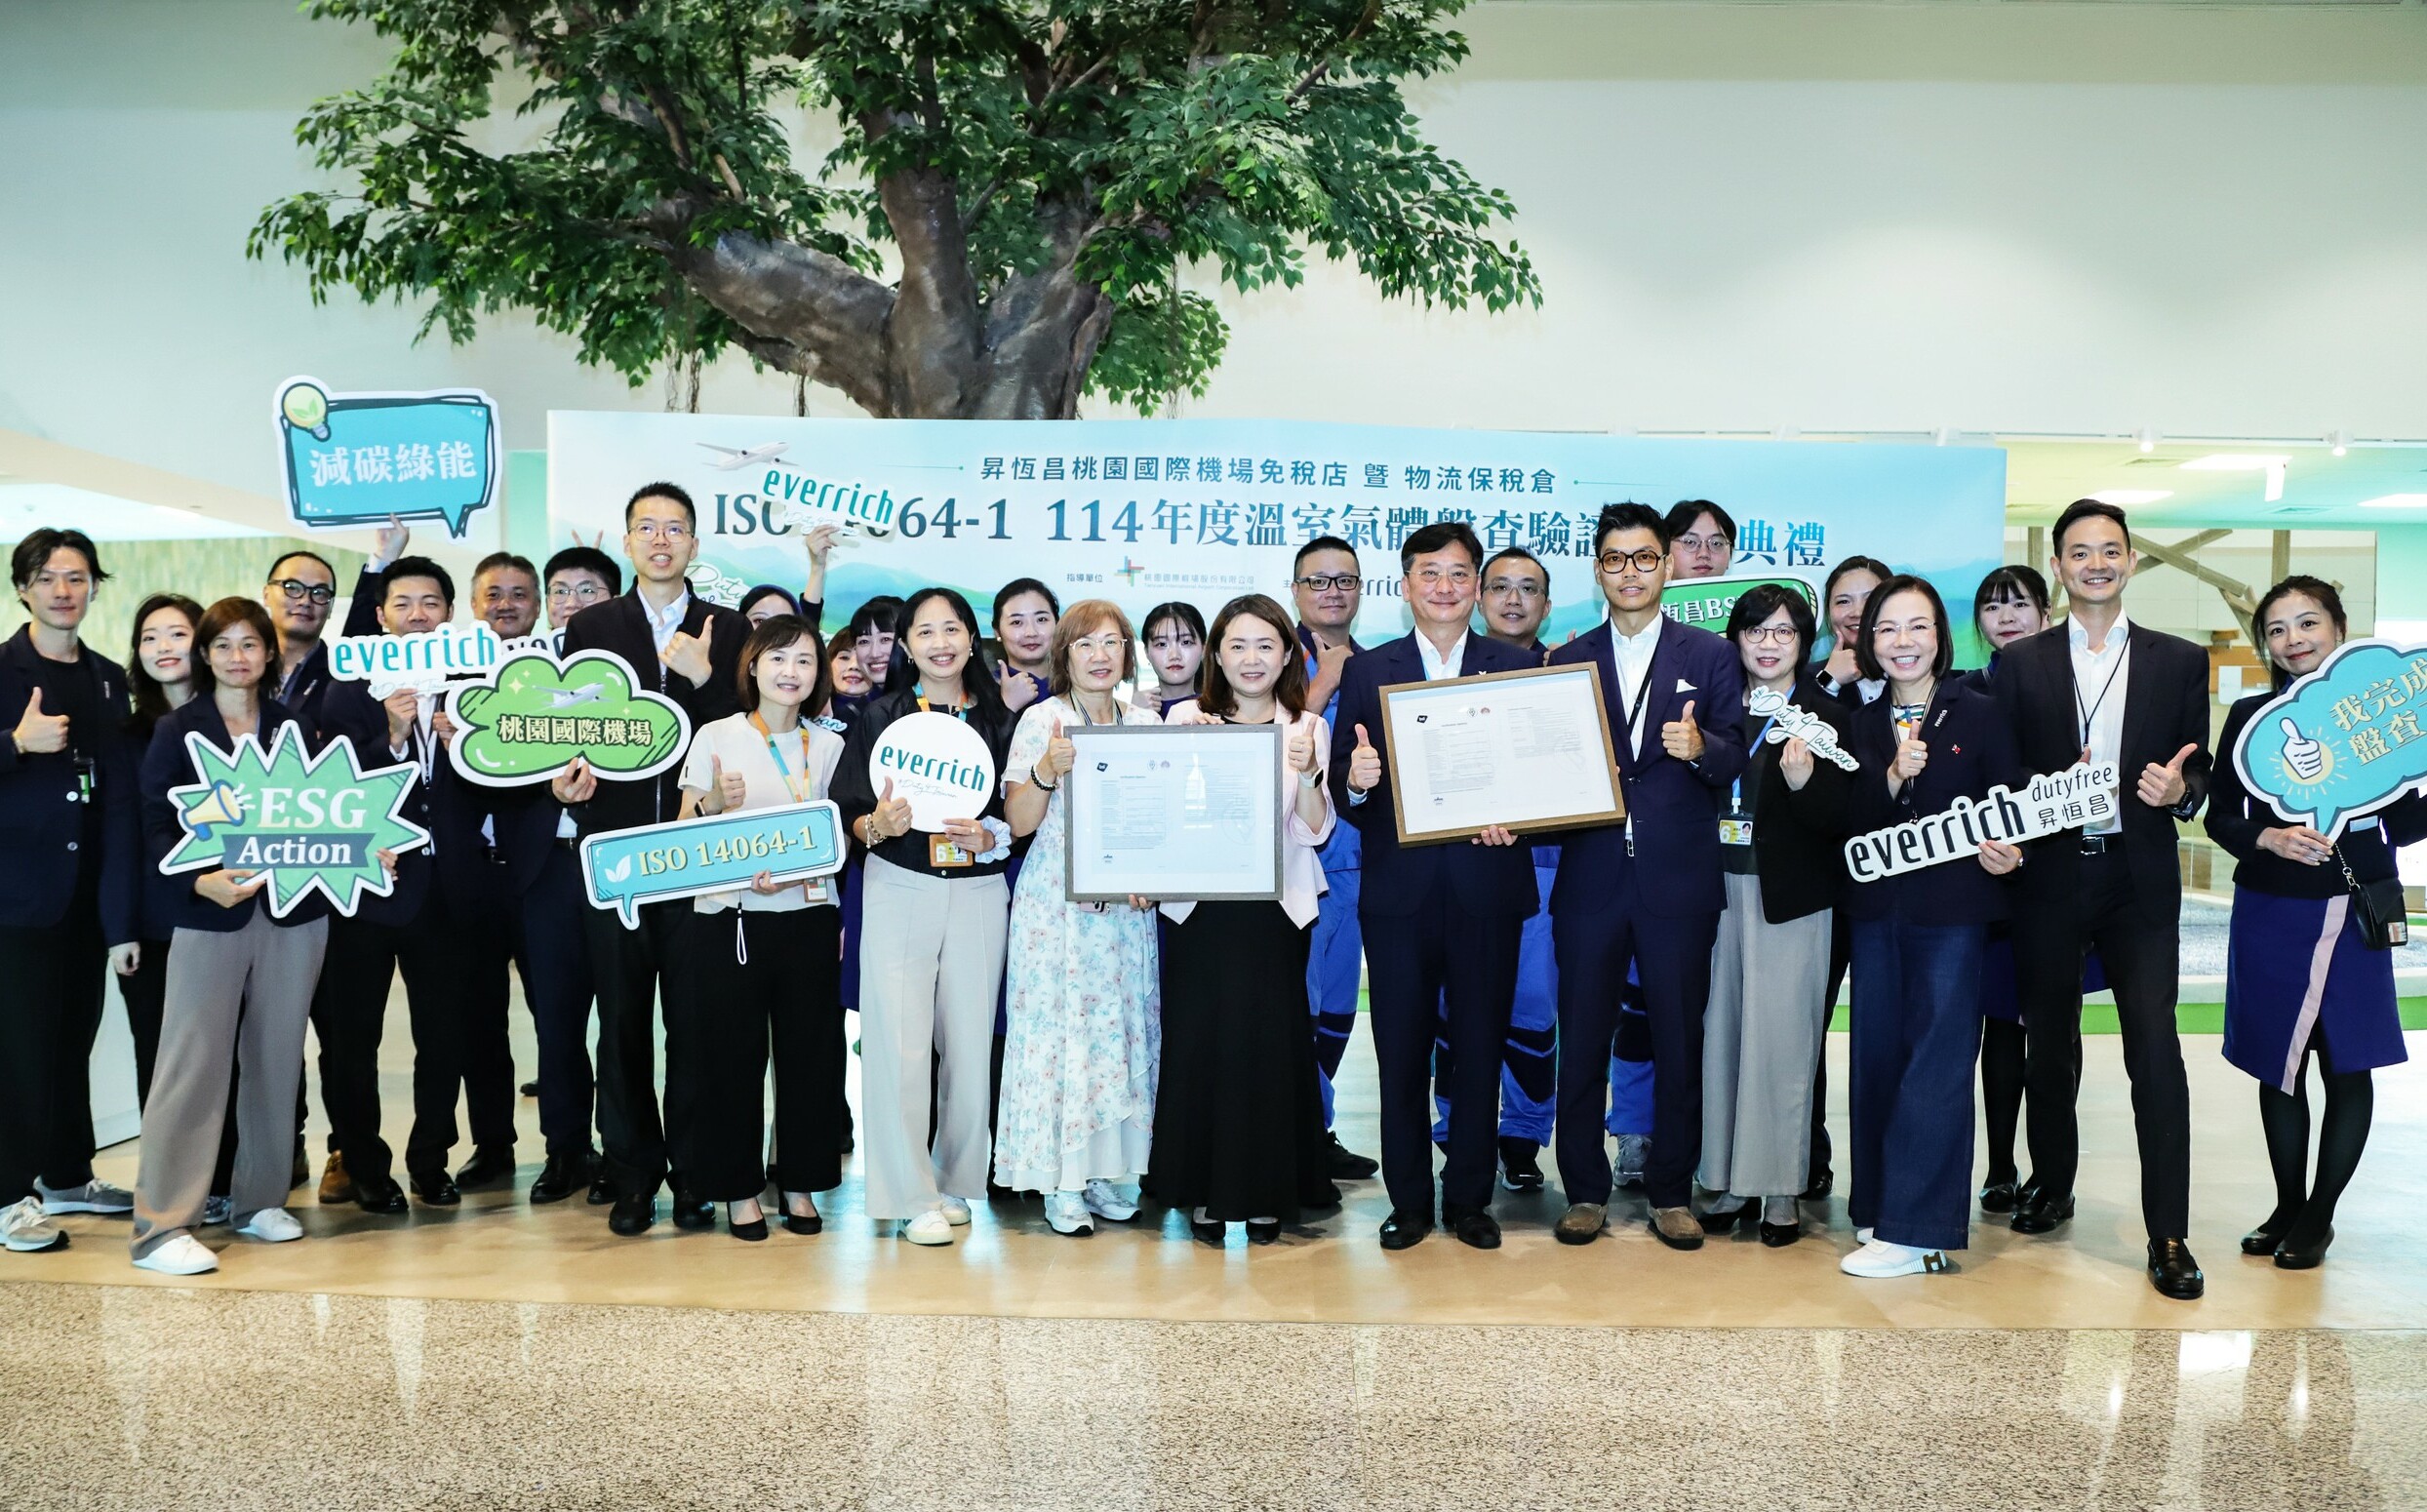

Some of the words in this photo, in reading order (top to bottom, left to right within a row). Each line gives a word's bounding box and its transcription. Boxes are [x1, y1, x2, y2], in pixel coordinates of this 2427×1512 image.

[308, 441, 478, 488] 減碳綠能
[1364, 463, 1389, 488] 暨
[1405, 465, 1557, 495] 物流保稅倉
[762, 469, 895, 525] everrich
[335, 627, 496, 675] everrich
[2328, 657, 2427, 733] 我完成
[497, 714, 654, 746] 桃園國際機場
[2348, 699, 2427, 767] 盤查
[879, 745, 985, 792] everrich
[2031, 767, 2113, 803] dutyfree
[258, 785, 368, 830] ESG
[235, 837, 353, 866] Action
[637, 846, 688, 878] ISO
[695, 825, 818, 866] 14064-1
[1850, 791, 2027, 877] everrich
